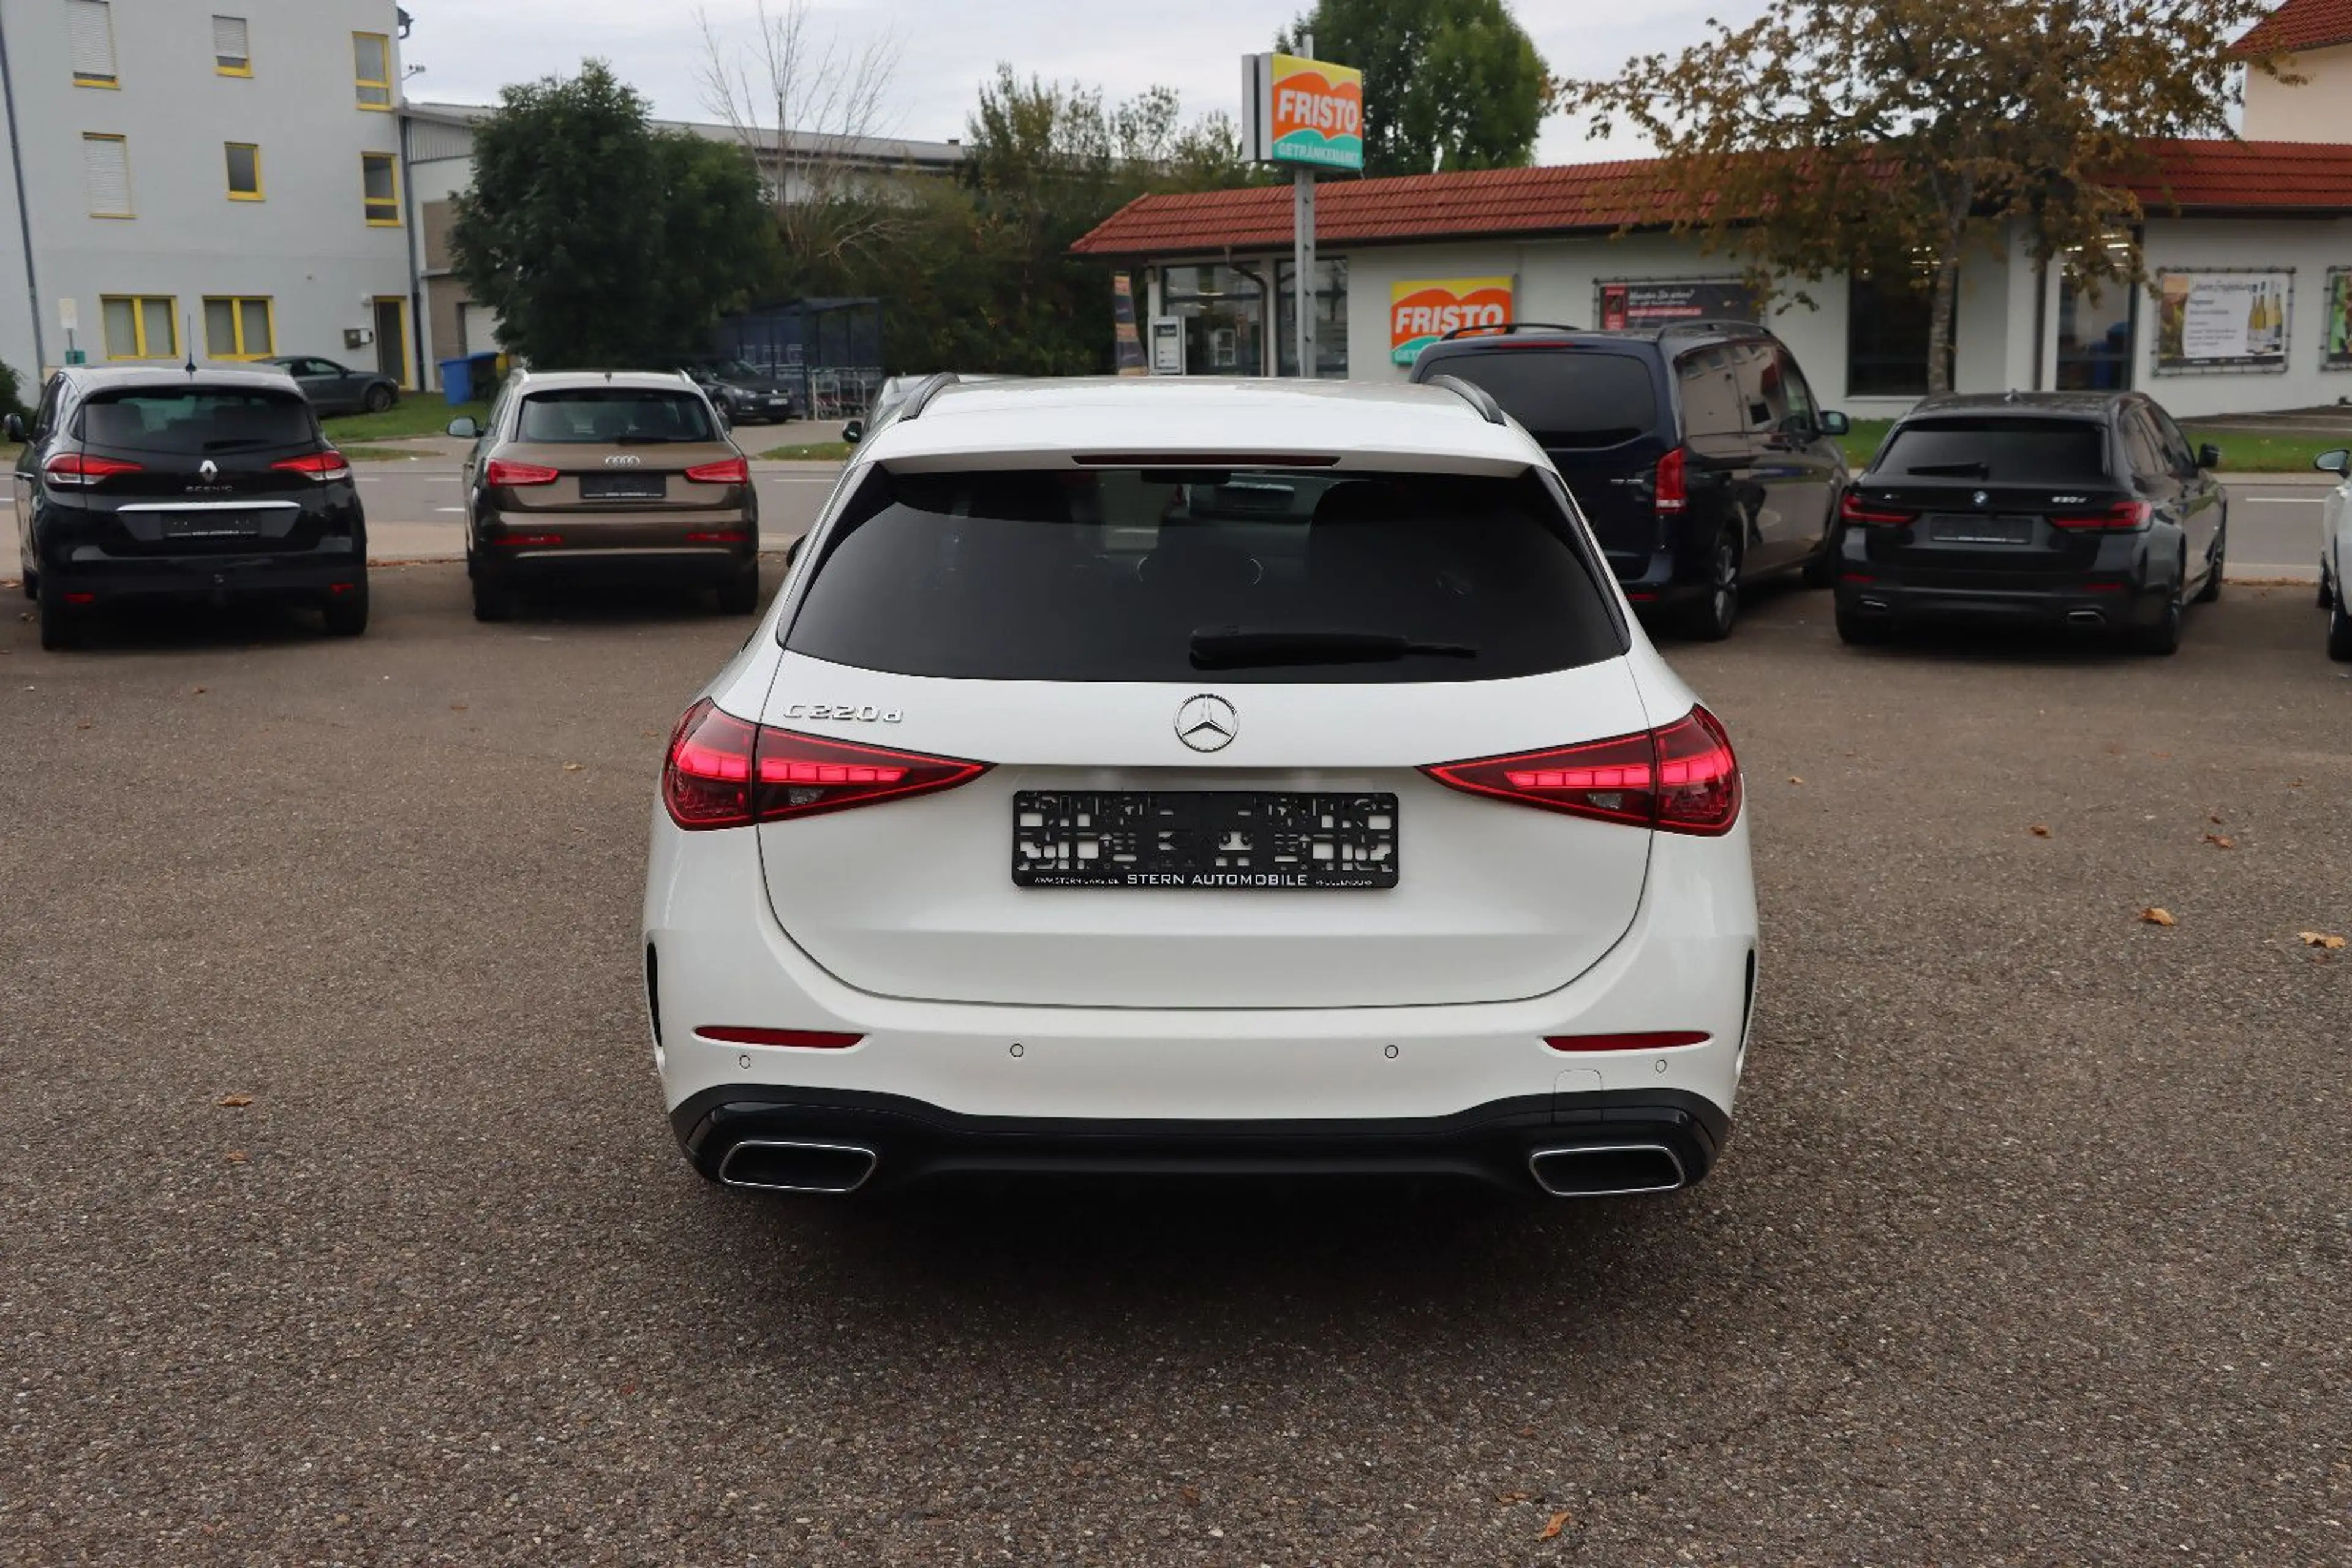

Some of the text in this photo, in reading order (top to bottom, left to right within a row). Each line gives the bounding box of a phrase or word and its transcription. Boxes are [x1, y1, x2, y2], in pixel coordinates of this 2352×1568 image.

[1278, 89, 1359, 132] FRISTO
[1395, 304, 1504, 334] FRISTO
[1127, 874, 1185, 884] STERN
[1191, 874, 1308, 886] AUTOMOBILE
